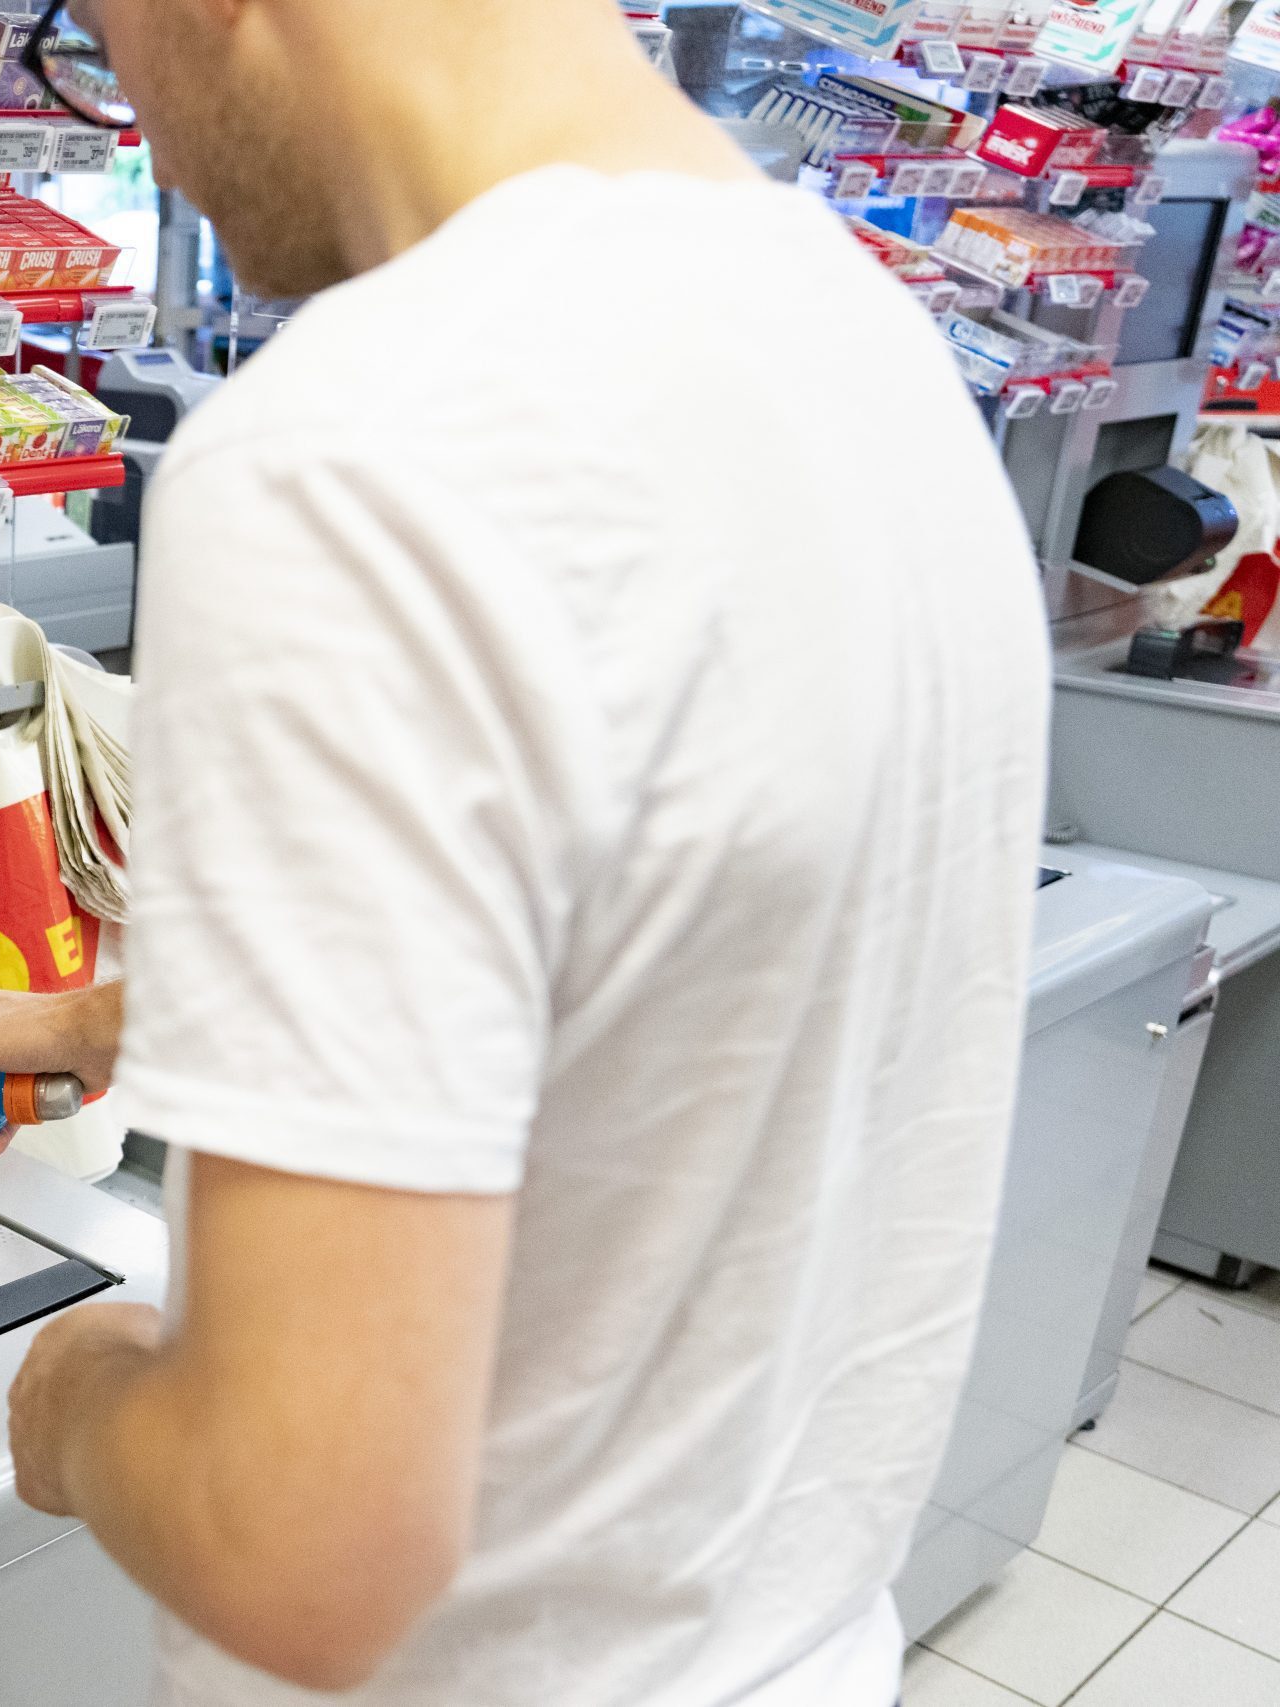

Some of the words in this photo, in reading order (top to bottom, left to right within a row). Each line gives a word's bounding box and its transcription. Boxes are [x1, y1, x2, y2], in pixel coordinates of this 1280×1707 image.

[9, 31, 55, 49] Läkrol
[20, 250, 57, 272] CRUSH
[66, 249, 102, 271] CRUSH
[22, 448, 48, 460] Dent
